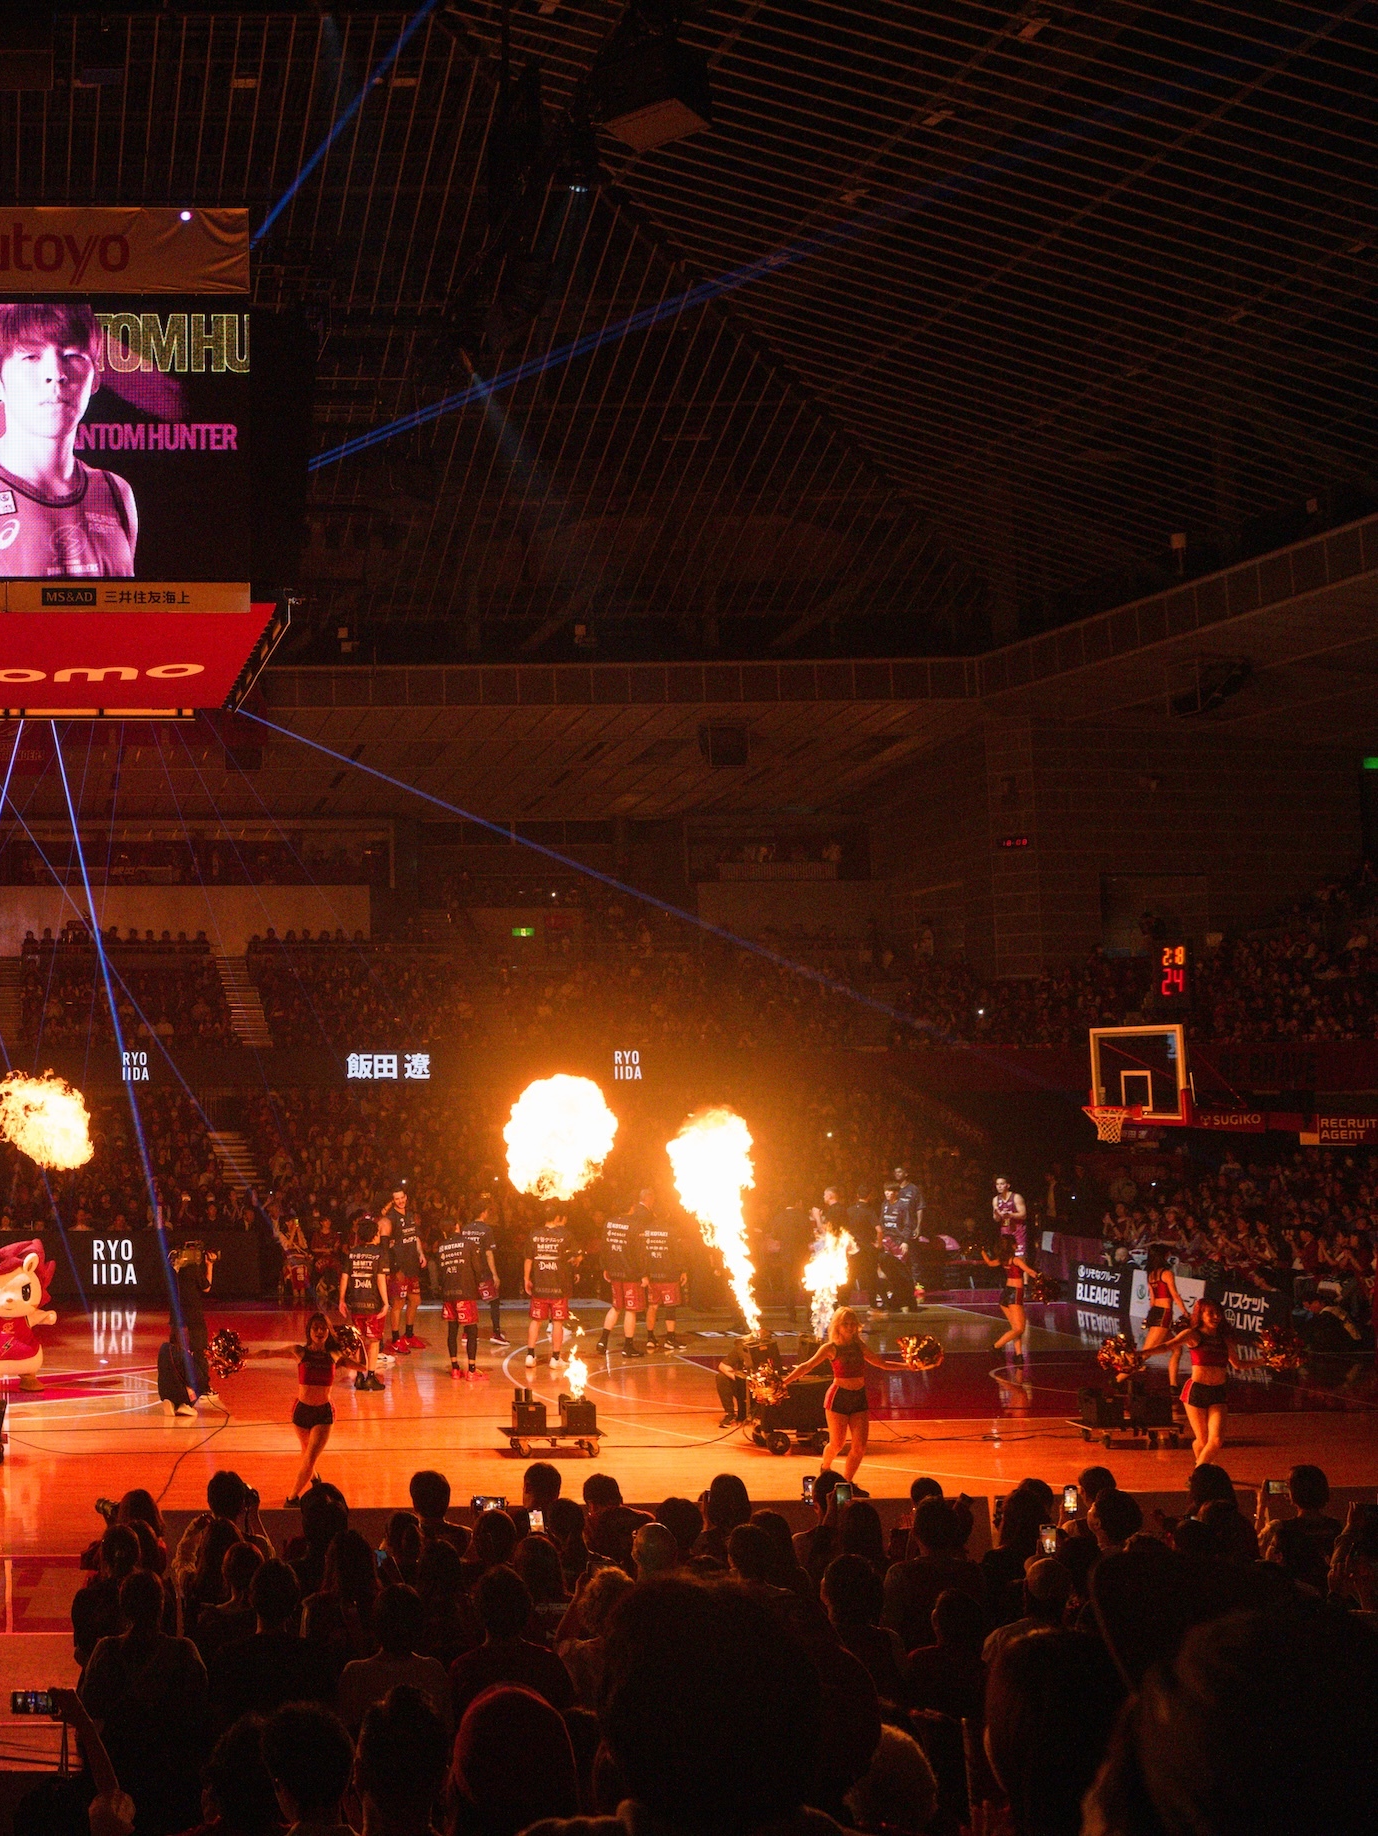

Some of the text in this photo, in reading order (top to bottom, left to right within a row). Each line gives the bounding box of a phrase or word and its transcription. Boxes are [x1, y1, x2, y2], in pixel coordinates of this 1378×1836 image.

[148, 423, 238, 450] HUNTER
[46, 591, 190, 604] MS&AD 三井住友海上
[1162, 968, 1183, 995] 24
[122, 1051, 148, 1066] RYO
[613, 1050, 640, 1065] RYO
[122, 1067, 150, 1081] IIDA
[345, 1052, 431, 1080] 飯田 遼
[613, 1066, 642, 1080] IIDA
[1213, 1113, 1261, 1126] SUGIKO
[1320, 1118, 1378, 1128] RECRUIT
[1320, 1129, 1366, 1140] AGENT
[92, 1239, 133, 1260] RYO
[92, 1263, 137, 1284] IIDA
[1086, 1267, 1121, 1283] りそなグループ
[1076, 1282, 1120, 1309] B.LEAGUE
[1220, 1291, 1270, 1313] バスケット
[1236, 1315, 1264, 1332] LIVE
